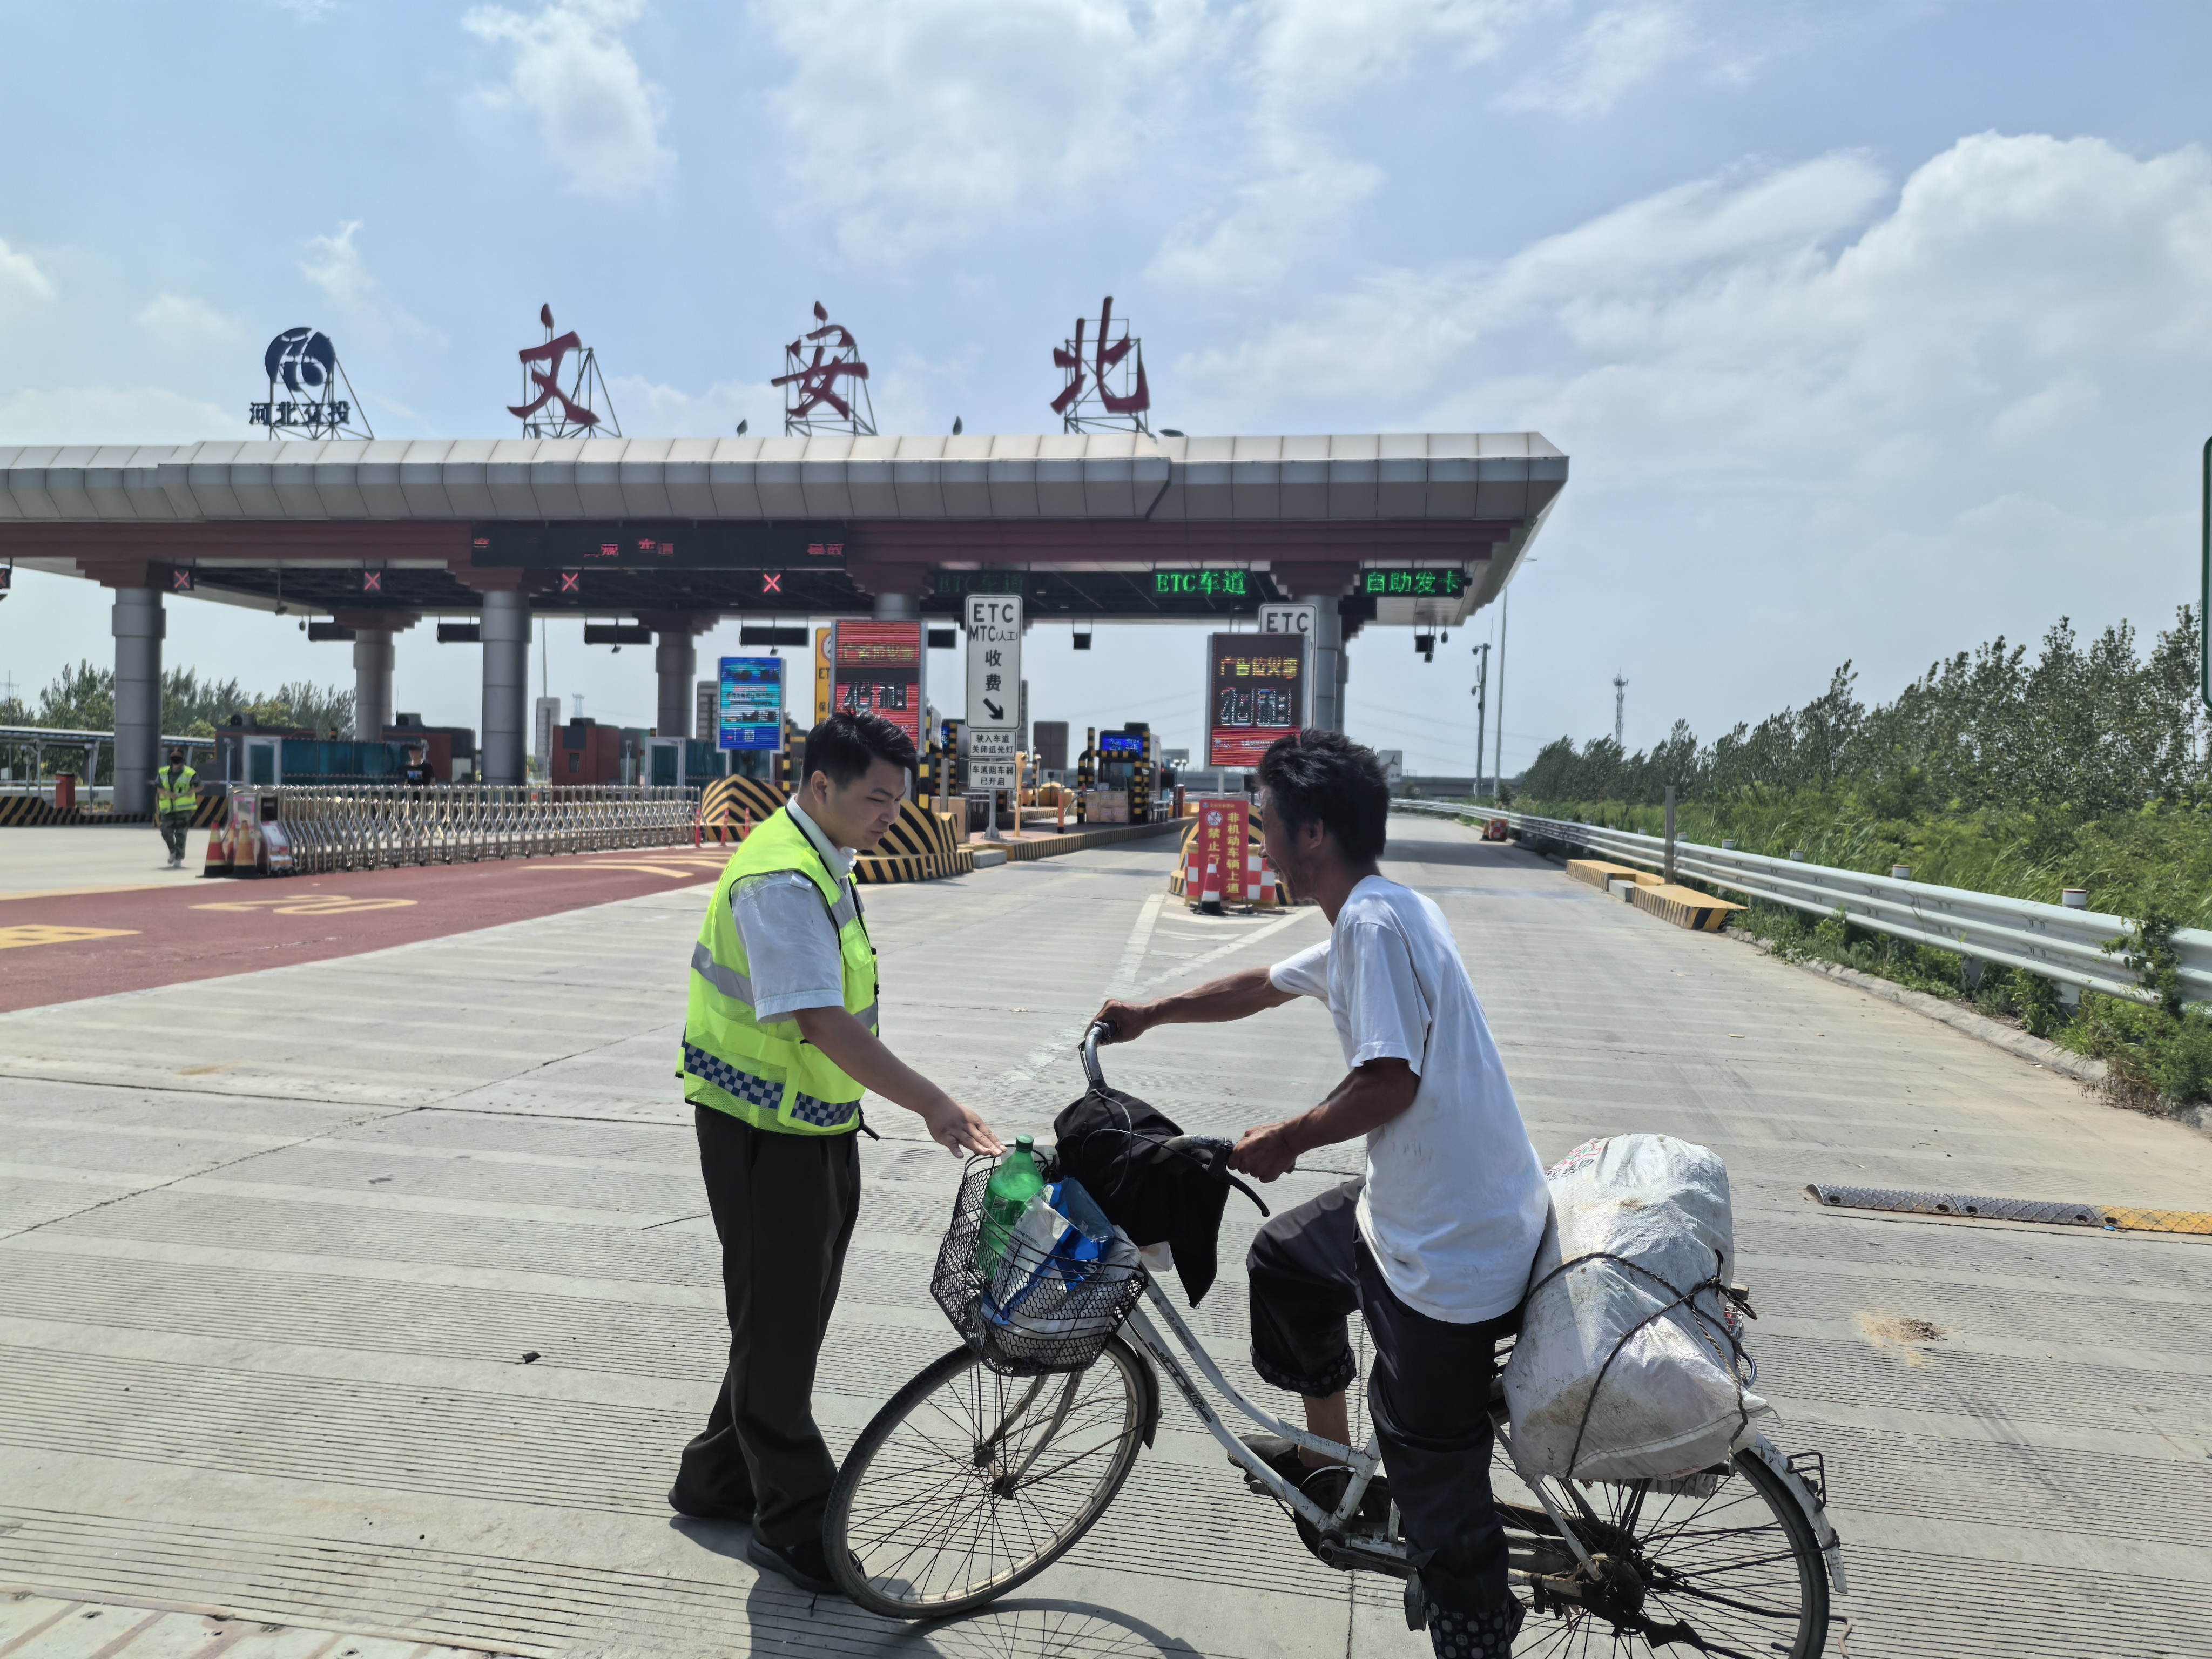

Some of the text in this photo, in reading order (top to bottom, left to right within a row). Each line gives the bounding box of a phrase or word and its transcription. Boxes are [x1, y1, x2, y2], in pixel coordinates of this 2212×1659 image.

[507, 296, 1150, 425] 文安北
[1155, 571, 1247, 595] ETC车道
[1367, 571, 1462, 594] 自助发卡
[974, 603, 1014, 623] ETC
[1267, 612, 1309, 632] ETC
[818, 667, 831, 679] ET
[985, 649, 1002, 692] 收费
[976, 734, 1010, 743] 驶入车道
[972, 745, 1014, 754] 关闭远光灯
[972, 765, 1014, 775] 车道阻车器
[981, 777, 1004, 786] 已开启
[1227, 812, 1240, 893] 非机动车辆上道
